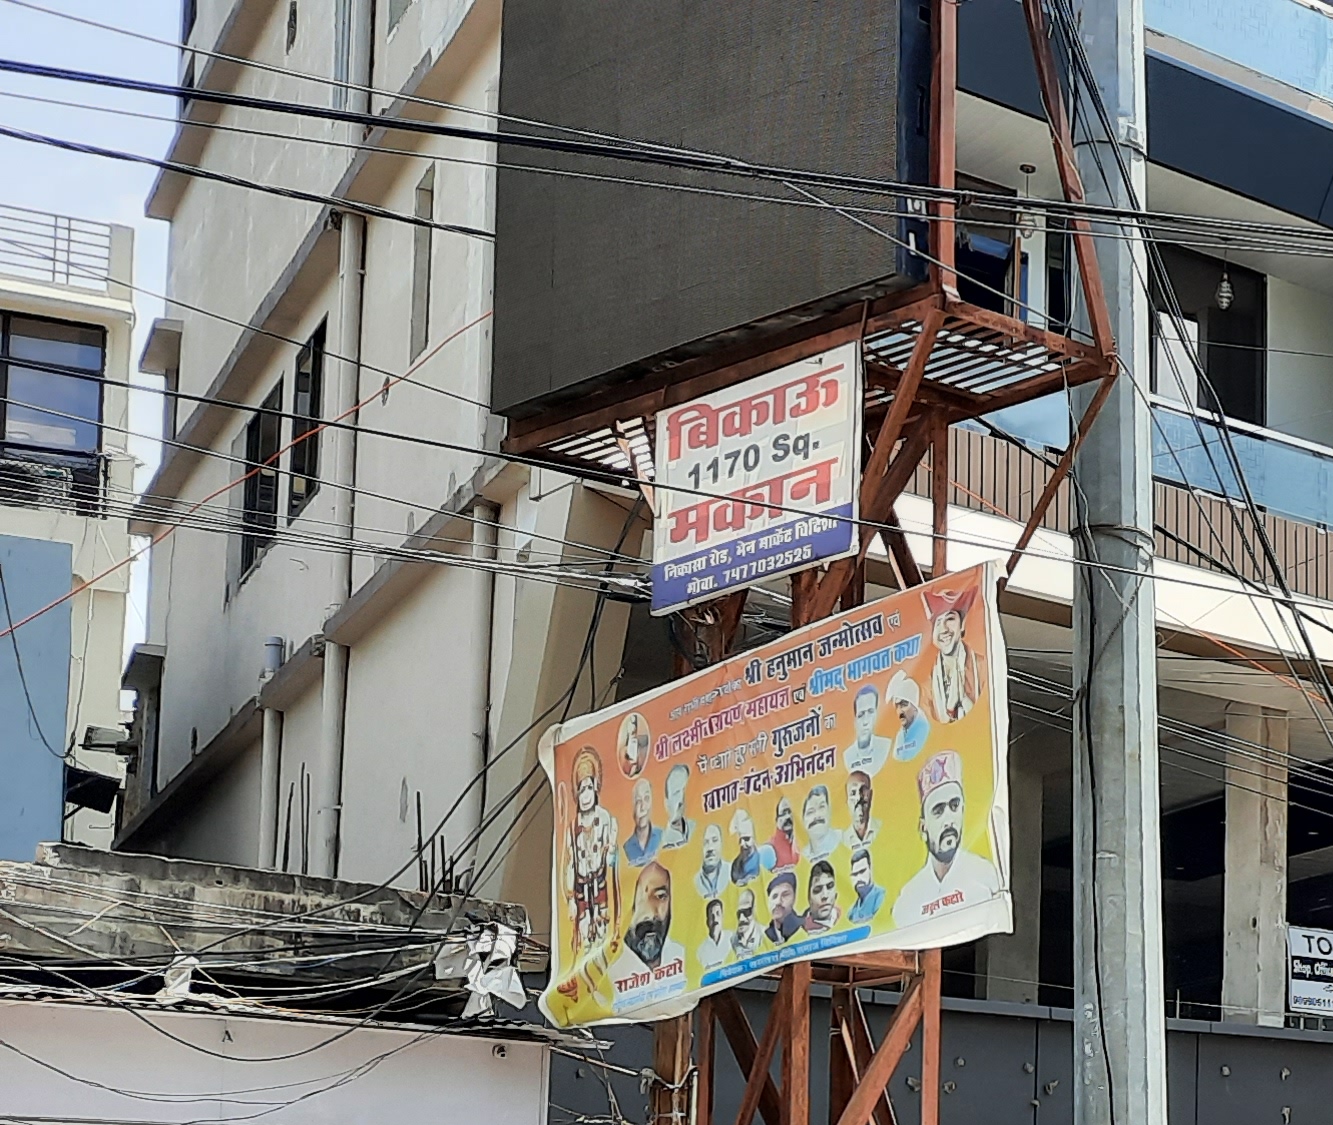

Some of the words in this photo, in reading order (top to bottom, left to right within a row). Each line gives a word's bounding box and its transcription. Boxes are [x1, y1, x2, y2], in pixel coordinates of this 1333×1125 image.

[666, 363, 845, 462] बिकाऊ
[688, 444, 761, 490] 1170
[771, 432, 820, 462] Sq.
[667, 457, 839, 545] मकान
[722, 544, 812, 584] 7477032525
[744, 659, 763, 685] श्री
[766, 642, 814, 688] हनुमान
[817, 613, 883, 657] जन्मोत्सव
[808, 668, 847, 697] श्रीमद्
[846, 648, 894, 680] भागवत
[1302, 935, 1333, 956] TO
[614, 971, 651, 993] राजेश
[652, 959, 684, 981] कटारे
